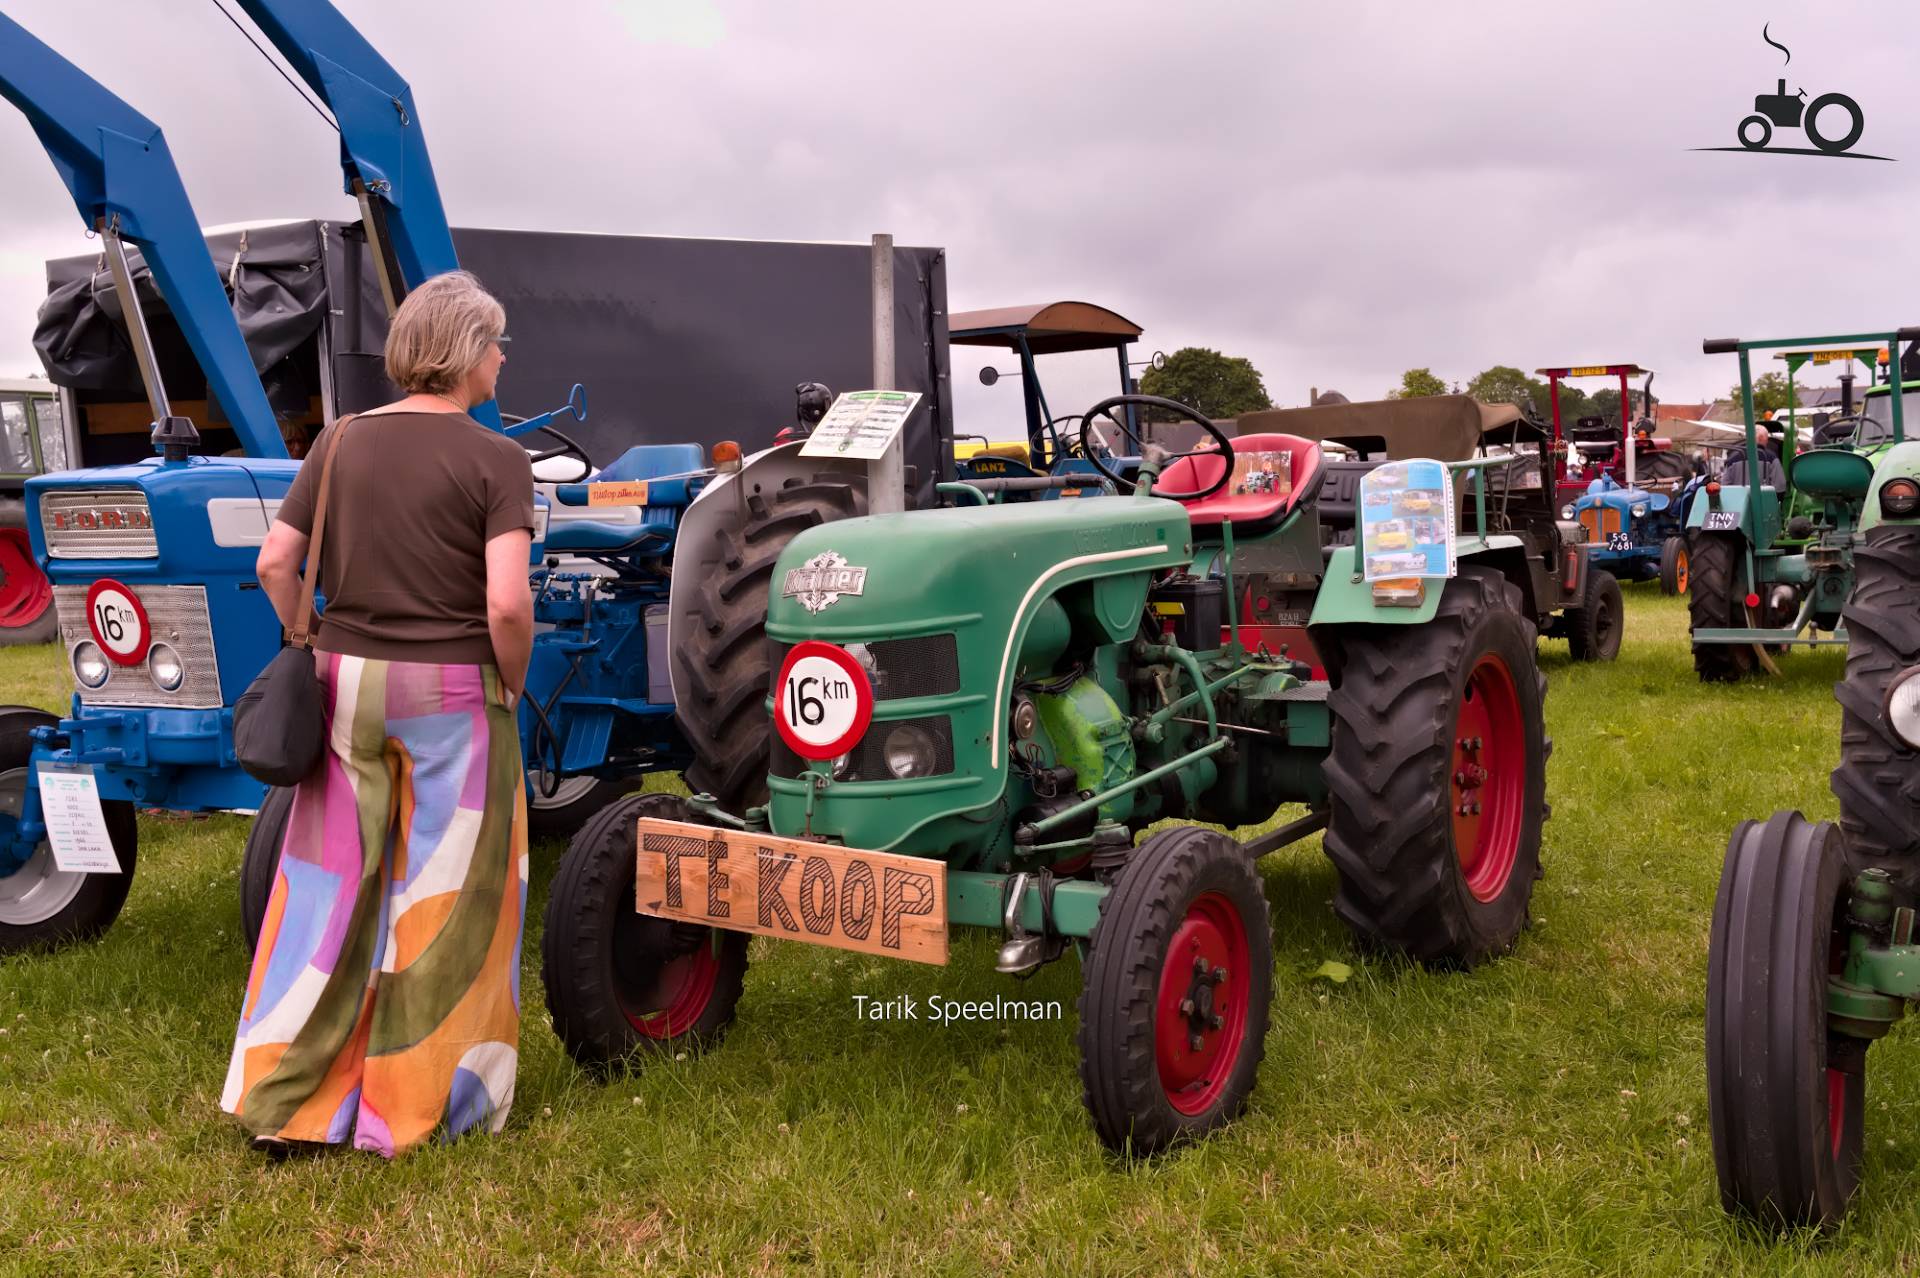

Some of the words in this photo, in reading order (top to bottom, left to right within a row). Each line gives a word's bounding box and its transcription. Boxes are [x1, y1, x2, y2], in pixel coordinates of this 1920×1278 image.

[975, 462, 1007, 473] LANZ
[52, 509, 151, 530] FORD
[1711, 512, 1735, 521] TNN
[95, 604, 124, 641] 16
[118, 606, 136, 624] km
[788, 677, 825, 727] 16
[822, 676, 849, 700] km
[643, 832, 731, 918] TE
[758, 846, 935, 950] KOOP
